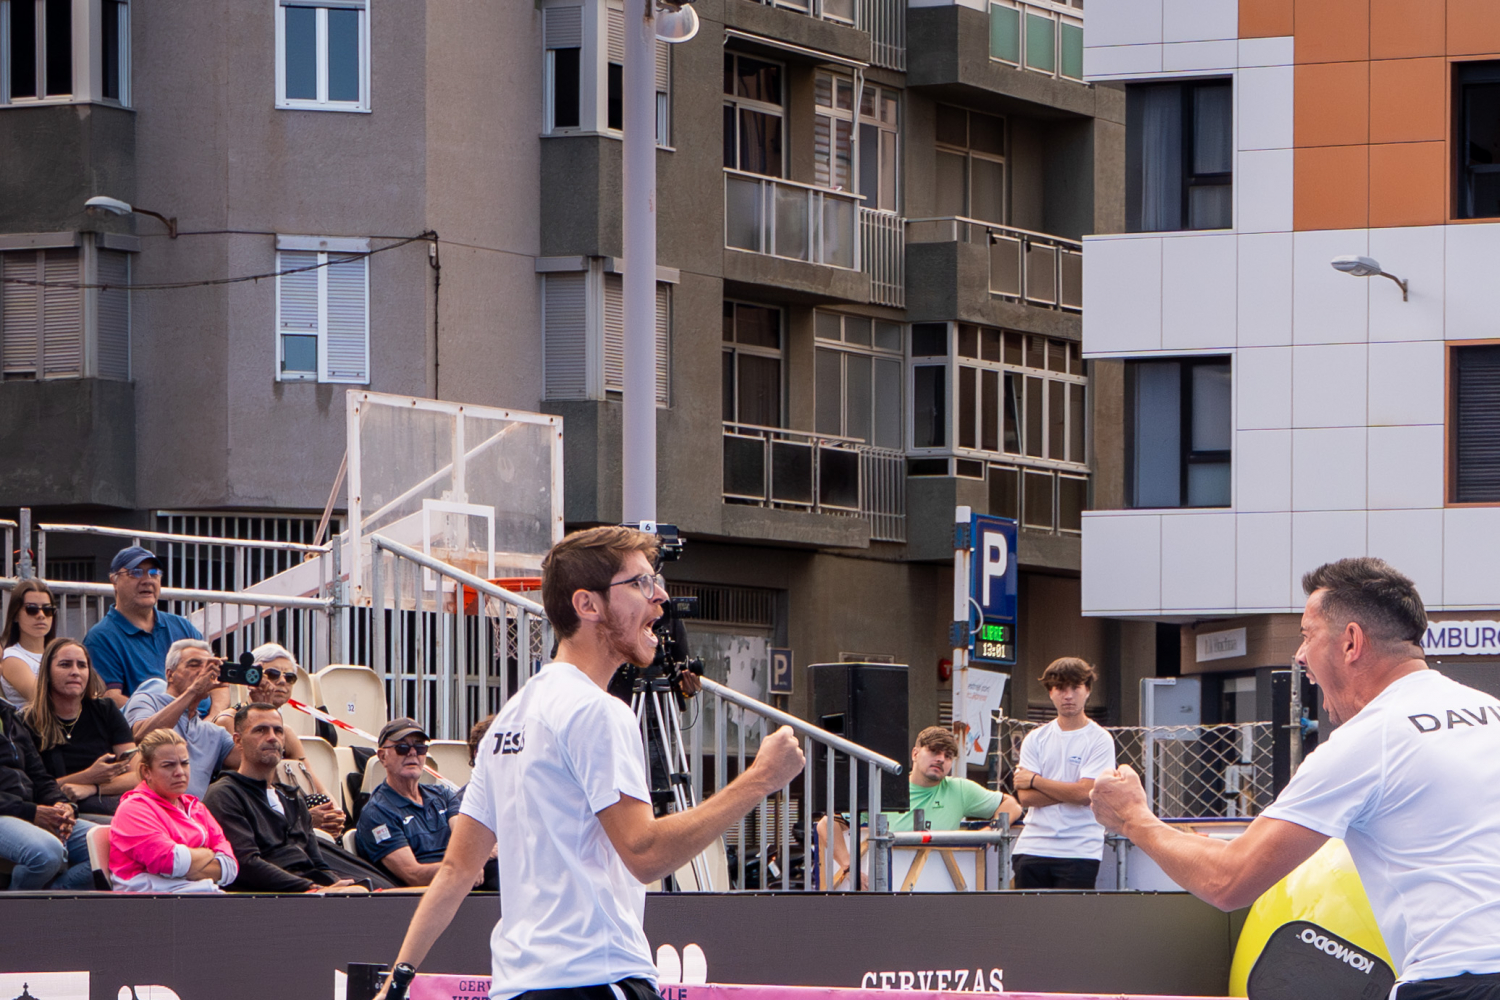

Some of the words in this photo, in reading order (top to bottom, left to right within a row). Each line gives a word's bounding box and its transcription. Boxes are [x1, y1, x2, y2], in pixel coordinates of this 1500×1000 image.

[645, 523, 651, 531] 6
[983, 532, 1007, 607] P
[983, 642, 1006, 659] 13:01
[774, 654, 787, 686] P
[493, 724, 525, 755] JES
[1301, 928, 1375, 975] KOMODO
